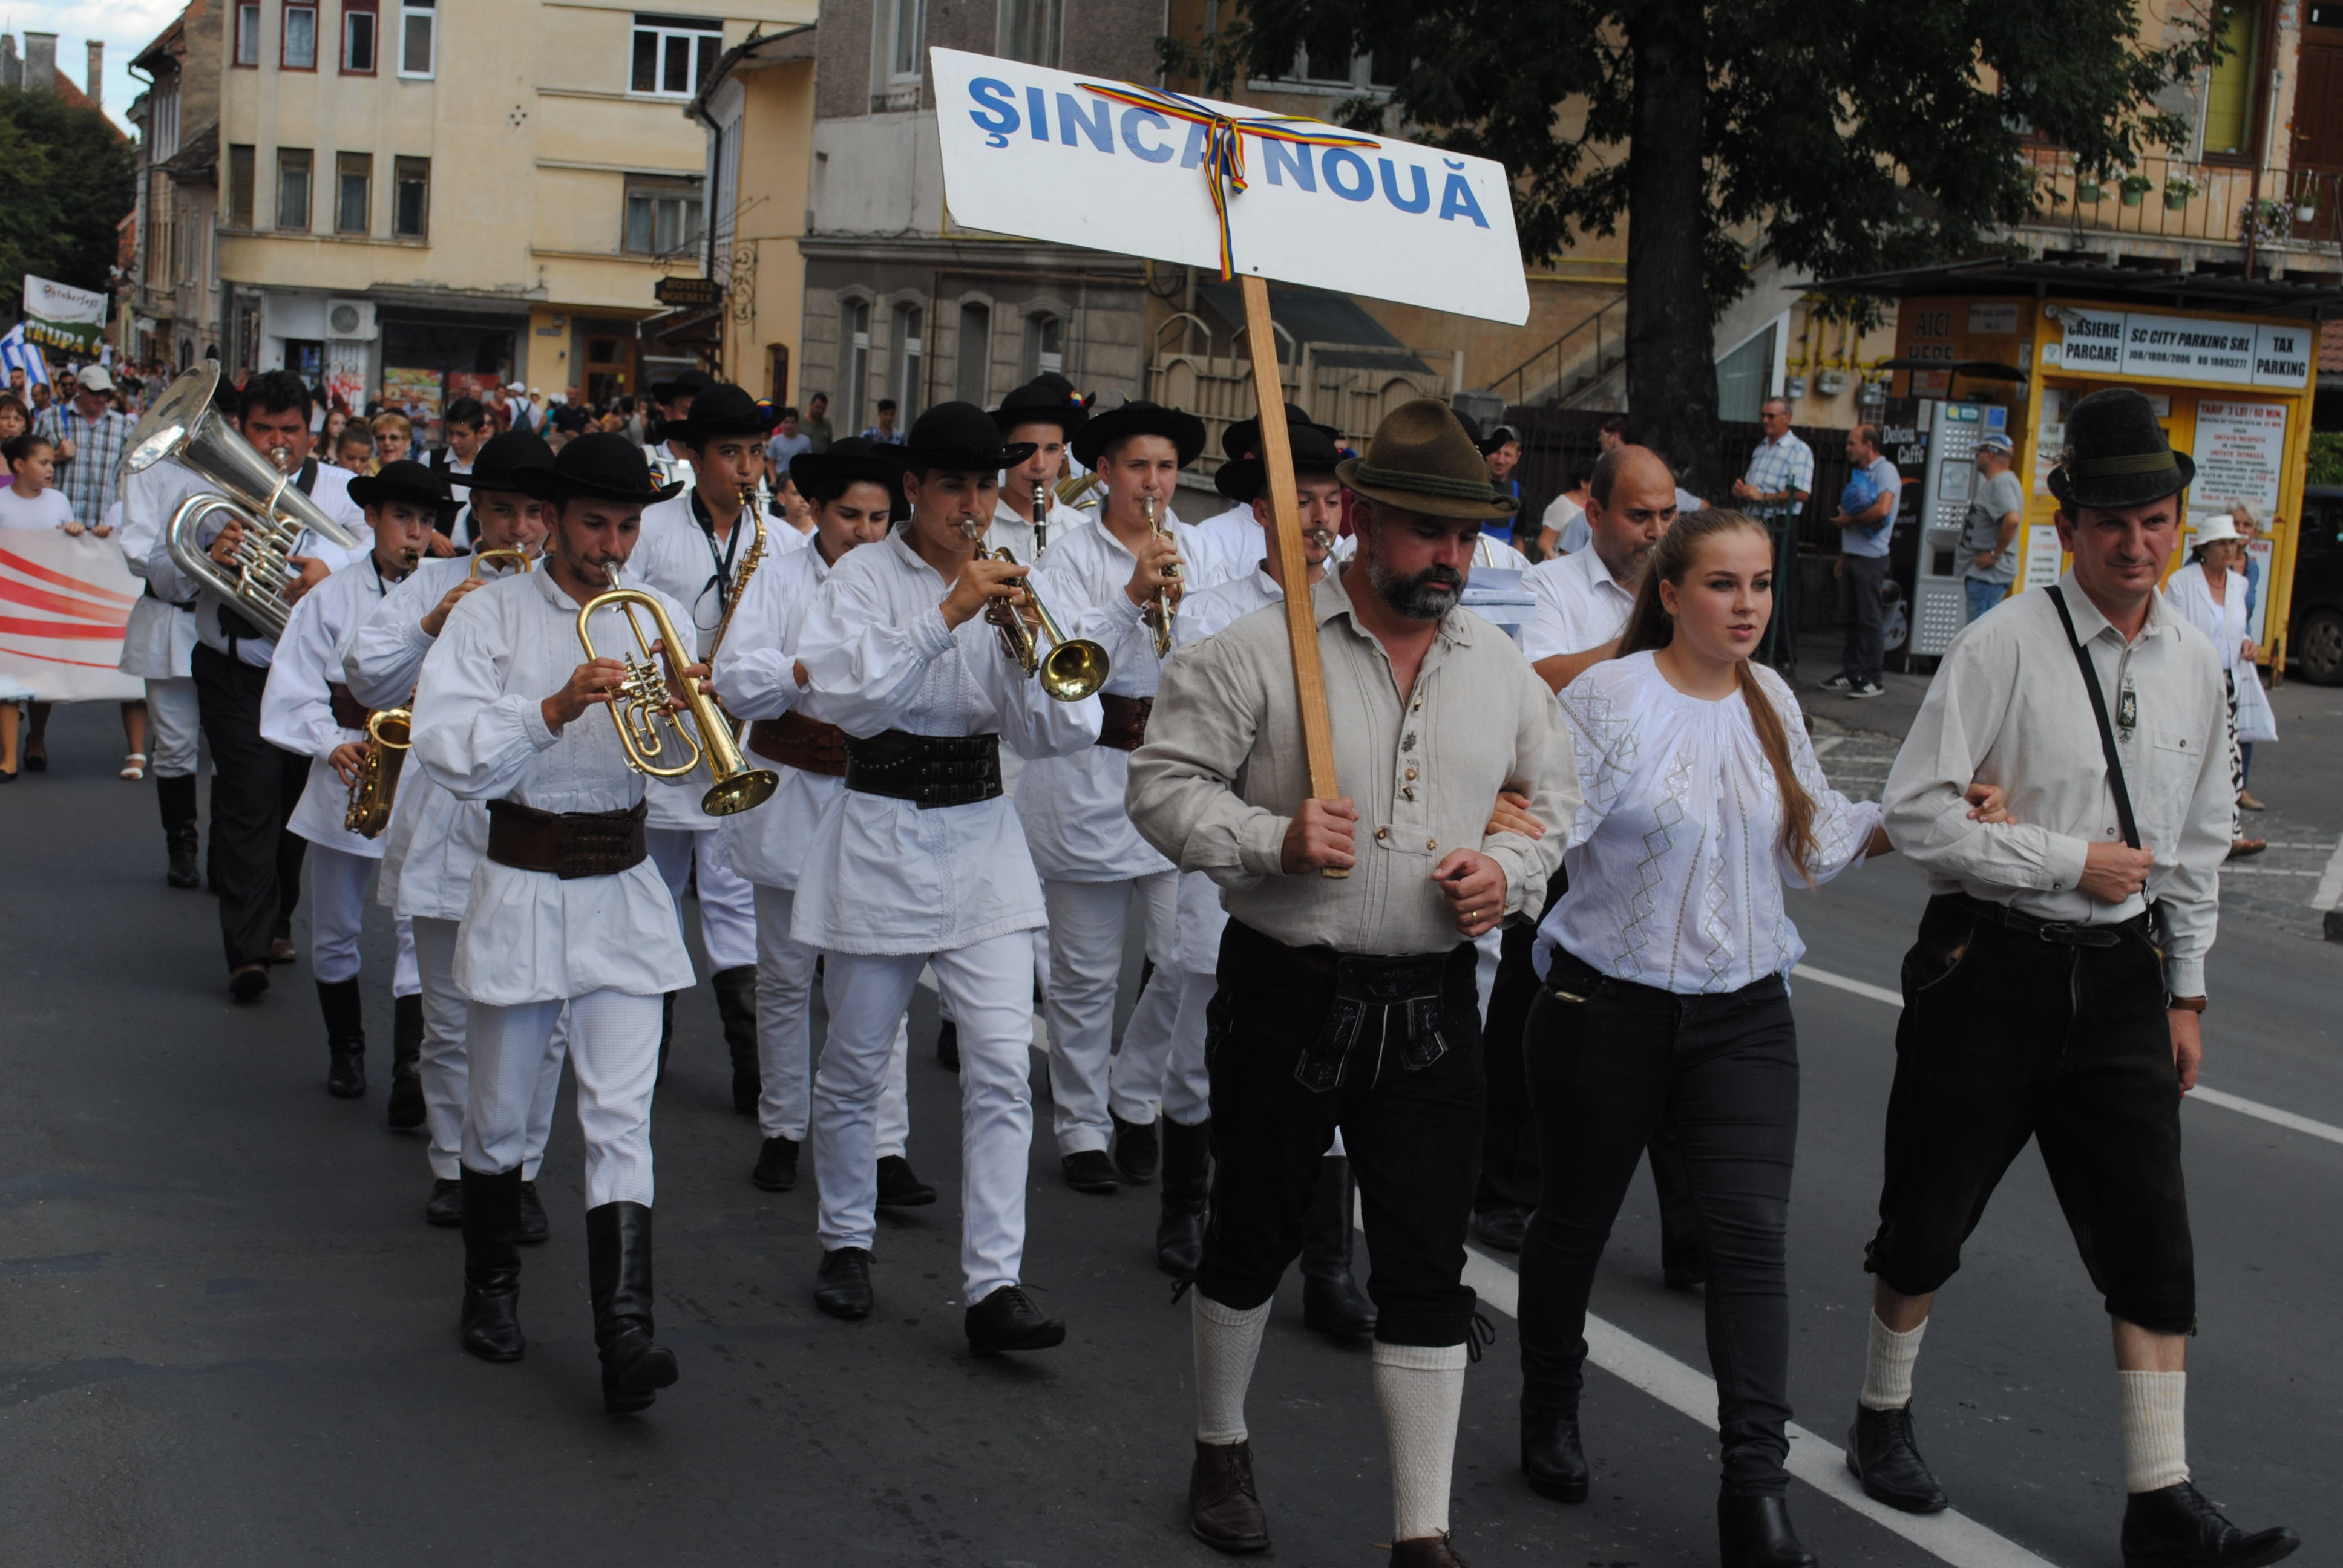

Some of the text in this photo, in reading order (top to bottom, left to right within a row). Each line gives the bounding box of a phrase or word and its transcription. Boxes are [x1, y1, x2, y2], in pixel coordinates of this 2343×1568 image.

[1261, 136, 1491, 230] NOUĂ
[666, 280, 715, 291] HOSTEL
[660, 291, 713, 302] BOEMIA
[1915, 310, 1951, 338] AICI
[25, 319, 84, 353] TRUPA
[2131, 328, 2250, 352] SC CITY PARKING SRL
[2273, 336, 2295, 354] TAX
[2066, 343, 2118, 362] PARCARE
[2256, 358, 2306, 377] PARKING
[2201, 403, 2224, 415] TARIF
[2235, 406, 2248, 417] LEI
